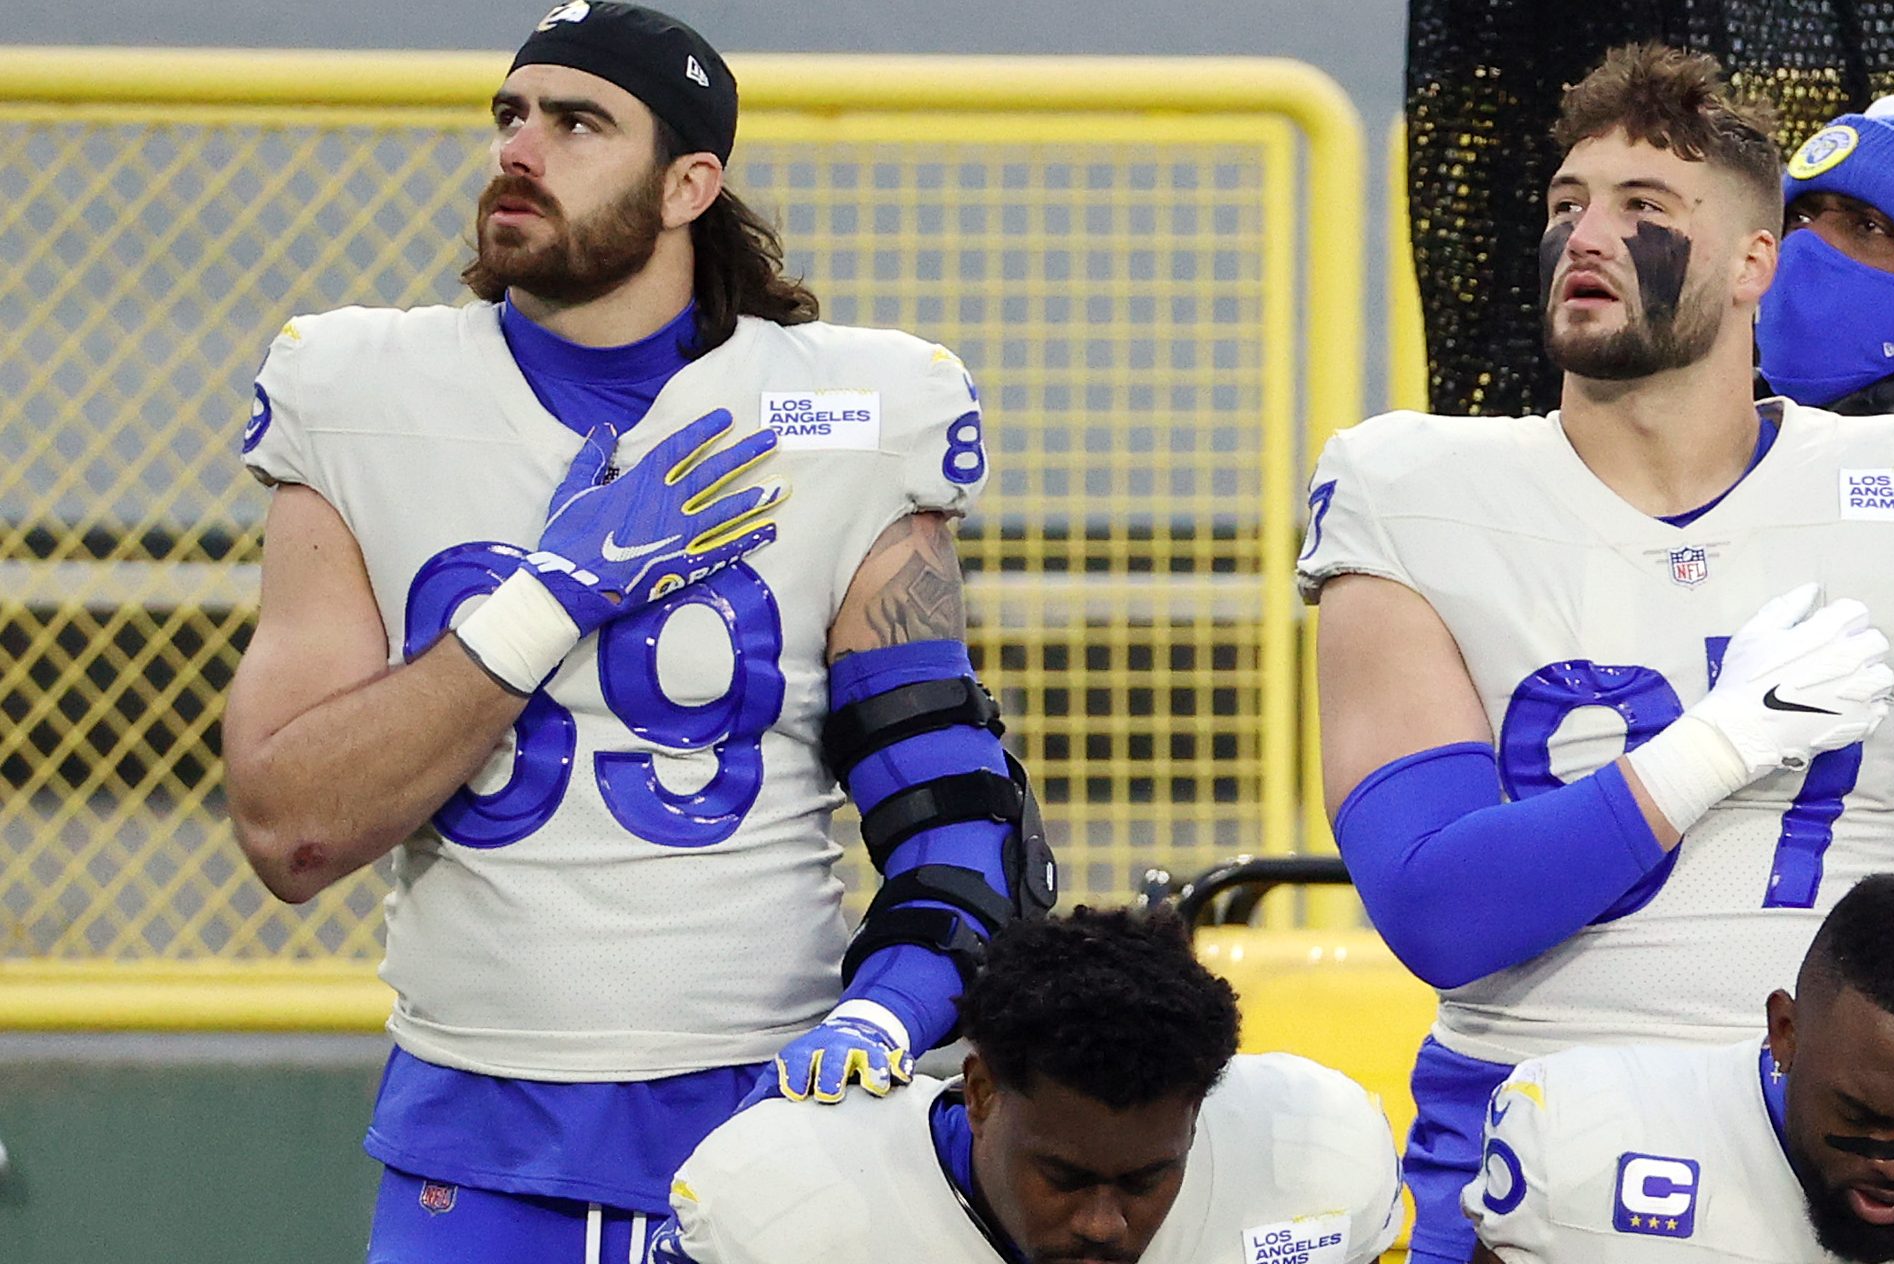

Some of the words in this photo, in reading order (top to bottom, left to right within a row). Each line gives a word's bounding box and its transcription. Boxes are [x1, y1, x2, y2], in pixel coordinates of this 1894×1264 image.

[769, 400, 812, 411] LOS
[769, 410, 870, 423] ANGELES
[769, 424, 832, 436] RAMS
[1849, 475, 1891, 486] LOS
[1676, 562, 1705, 581] NFL
[1621, 1157, 1694, 1216] C
[1253, 1229, 1292, 1248] LOS
[1256, 1233, 1342, 1260] ANGELES
